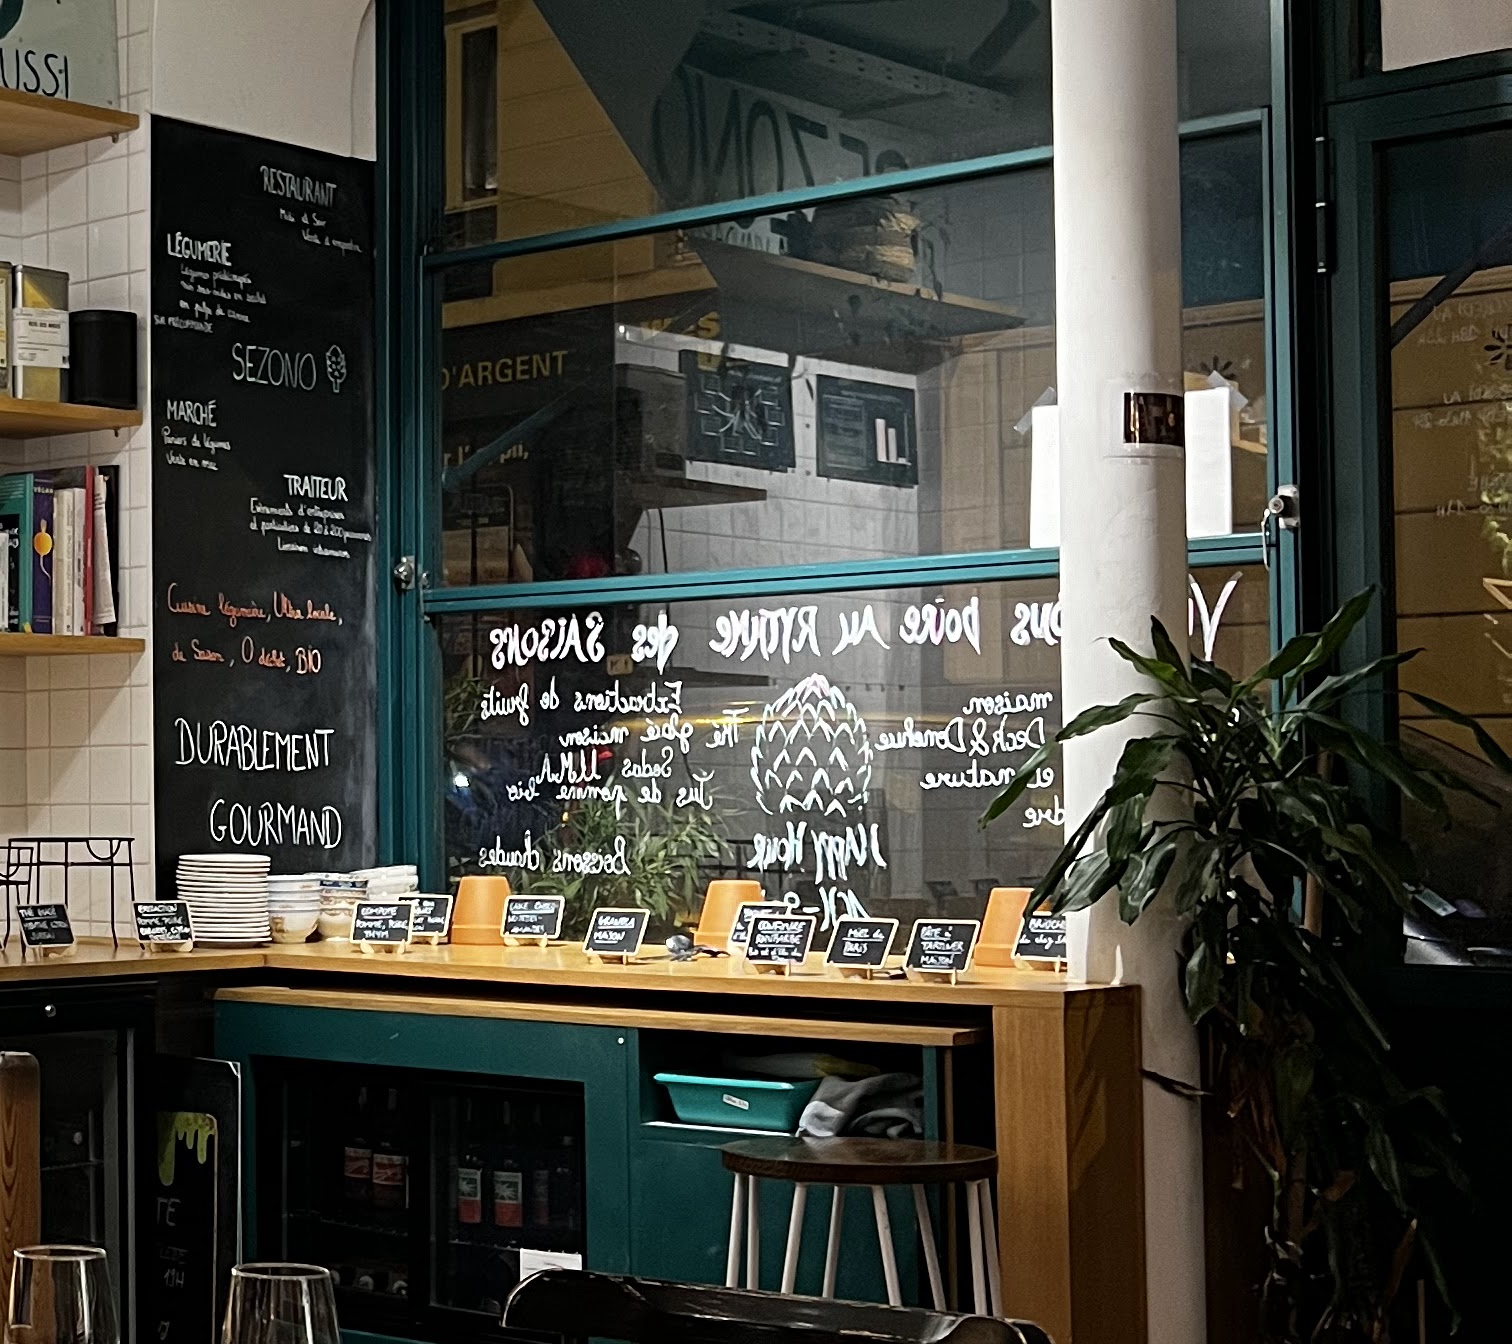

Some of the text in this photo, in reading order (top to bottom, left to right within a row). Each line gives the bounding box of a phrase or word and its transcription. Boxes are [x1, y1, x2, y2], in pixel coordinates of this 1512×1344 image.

[260, 165, 337, 207] RESTAURANT
[231, 342, 317, 391] SEZONO
[166, 399, 217, 427] MARCHÉ
[283, 474, 349, 502] TRAITEUR
[167, 582, 211, 616] Cuisine
[174, 717, 335, 772] DURABLEMENT
[209, 798, 342, 849] GOURMAND
